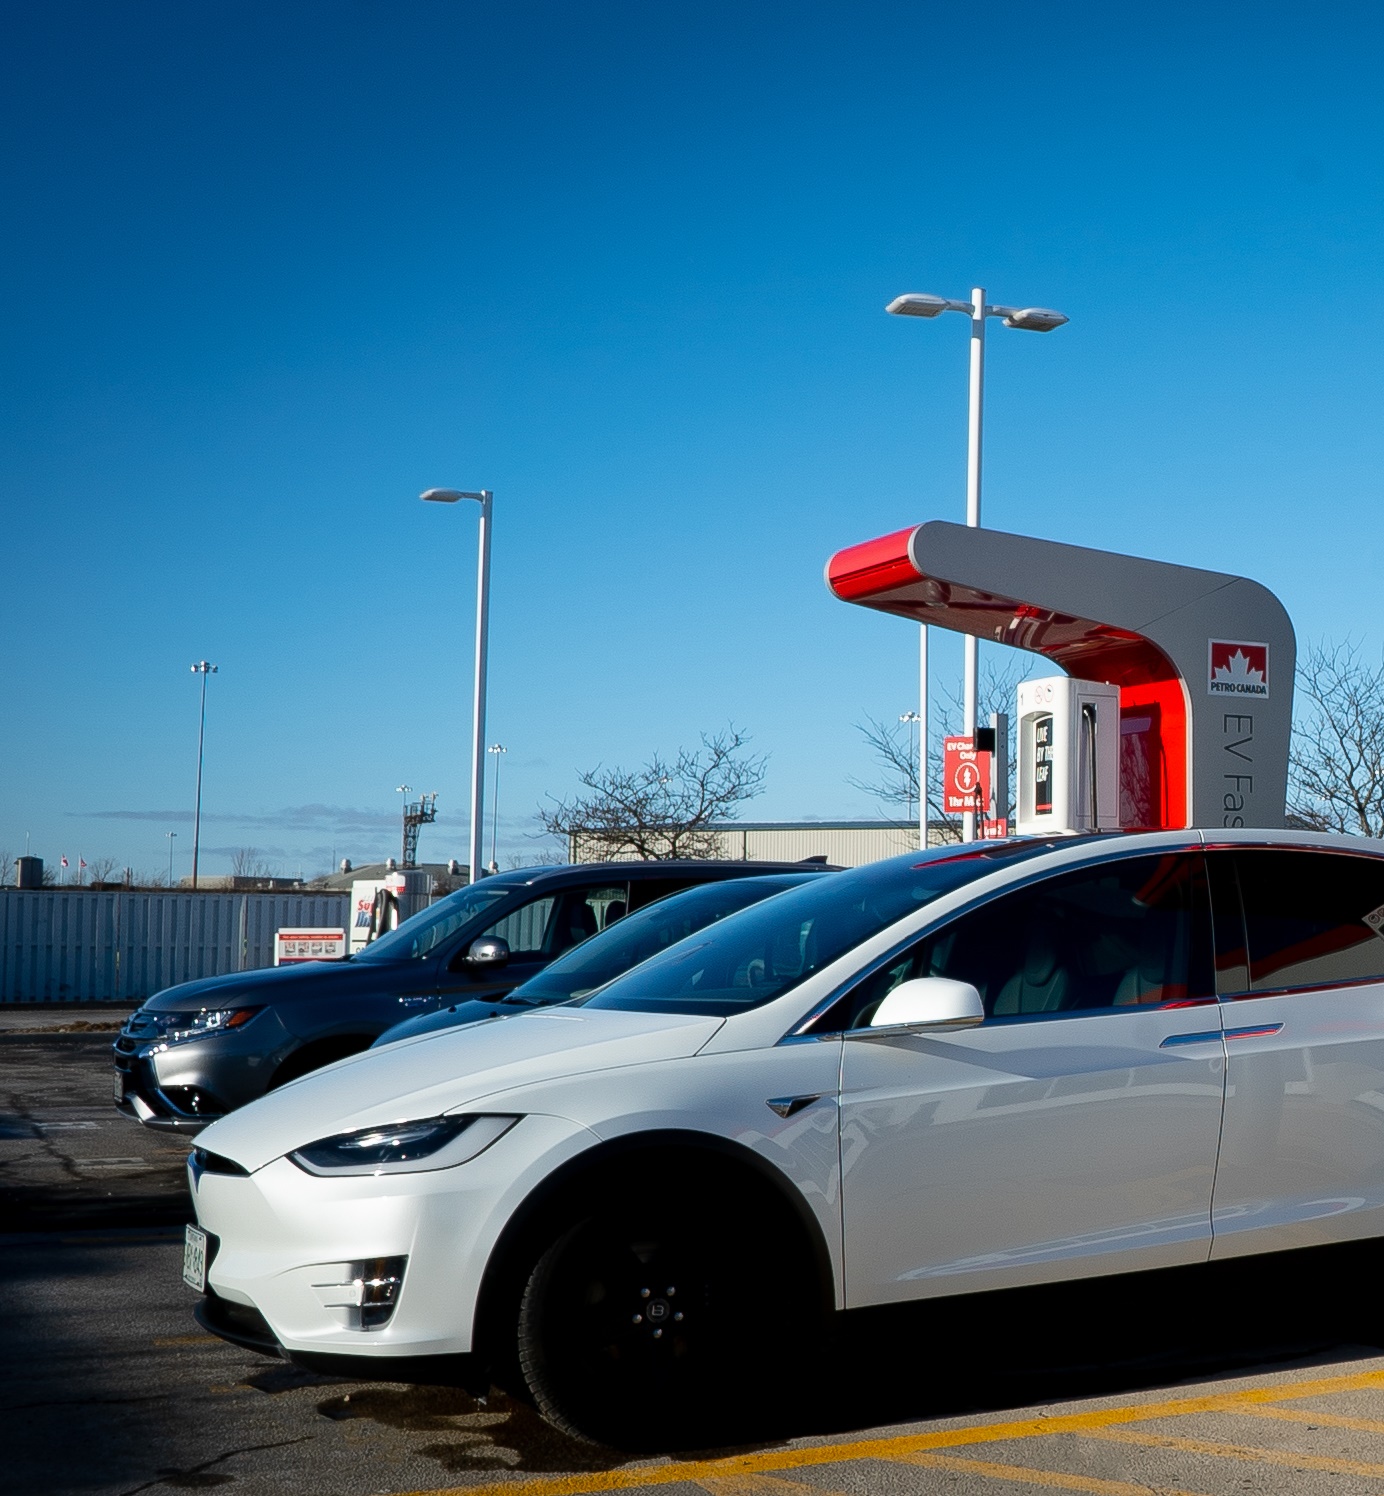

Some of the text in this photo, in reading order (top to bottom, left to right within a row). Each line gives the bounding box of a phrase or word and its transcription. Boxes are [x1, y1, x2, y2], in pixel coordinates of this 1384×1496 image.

[946, 741, 957, 751] EV
[959, 751, 977, 761] Only
[1224, 713, 1253, 828] EV Fas
